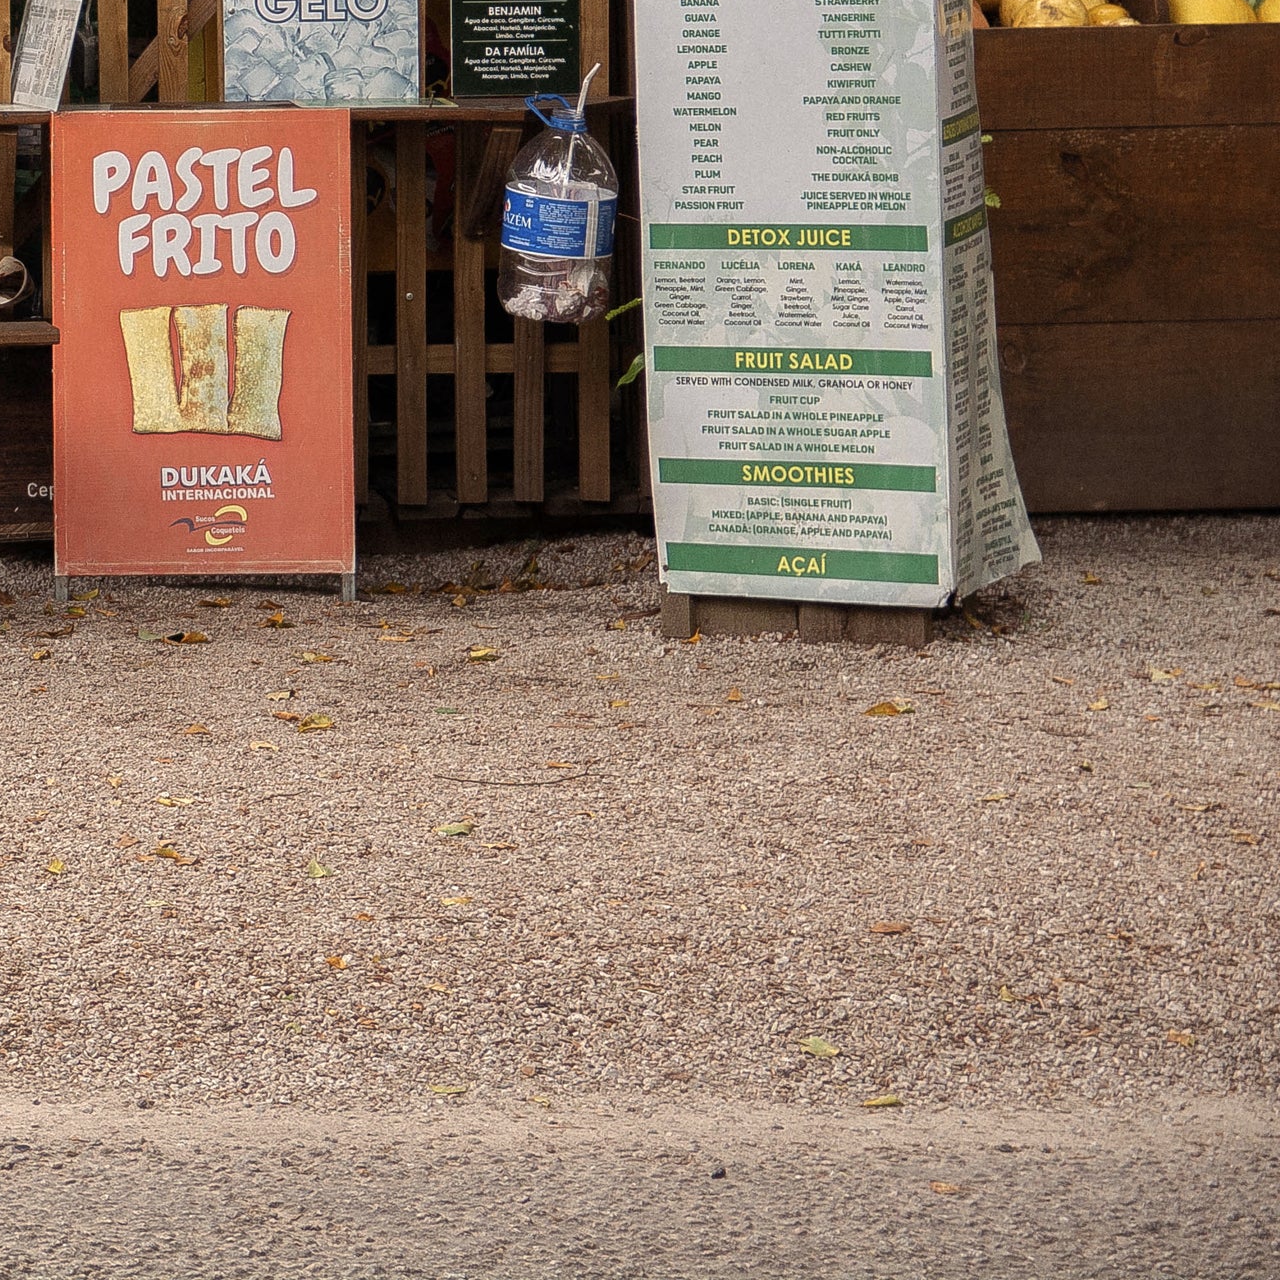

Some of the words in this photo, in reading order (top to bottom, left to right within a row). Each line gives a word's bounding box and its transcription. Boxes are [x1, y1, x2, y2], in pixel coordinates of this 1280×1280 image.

[489, 6, 541, 16] BENJAMIN
[683, 29, 720, 38] ORANGE
[688, 61, 717, 69] APPLE
[687, 92, 721, 100] MANGO
[92, 145, 318, 215] PASTEL
[118, 212, 297, 278] FRITO
[728, 229, 790, 245] DETOX
[797, 230, 850, 245] JUICE
[654, 260, 705, 270] FERNANDO
[736, 352, 783, 368] FRUIT
[789, 353, 852, 370] SALAD
[161, 459, 272, 487] DUKAKÁ
[742, 465, 854, 486] SMOOTHIES
[163, 488, 274, 500] INTERNACIONAL
[777, 554, 827, 577] AÇAÍ
